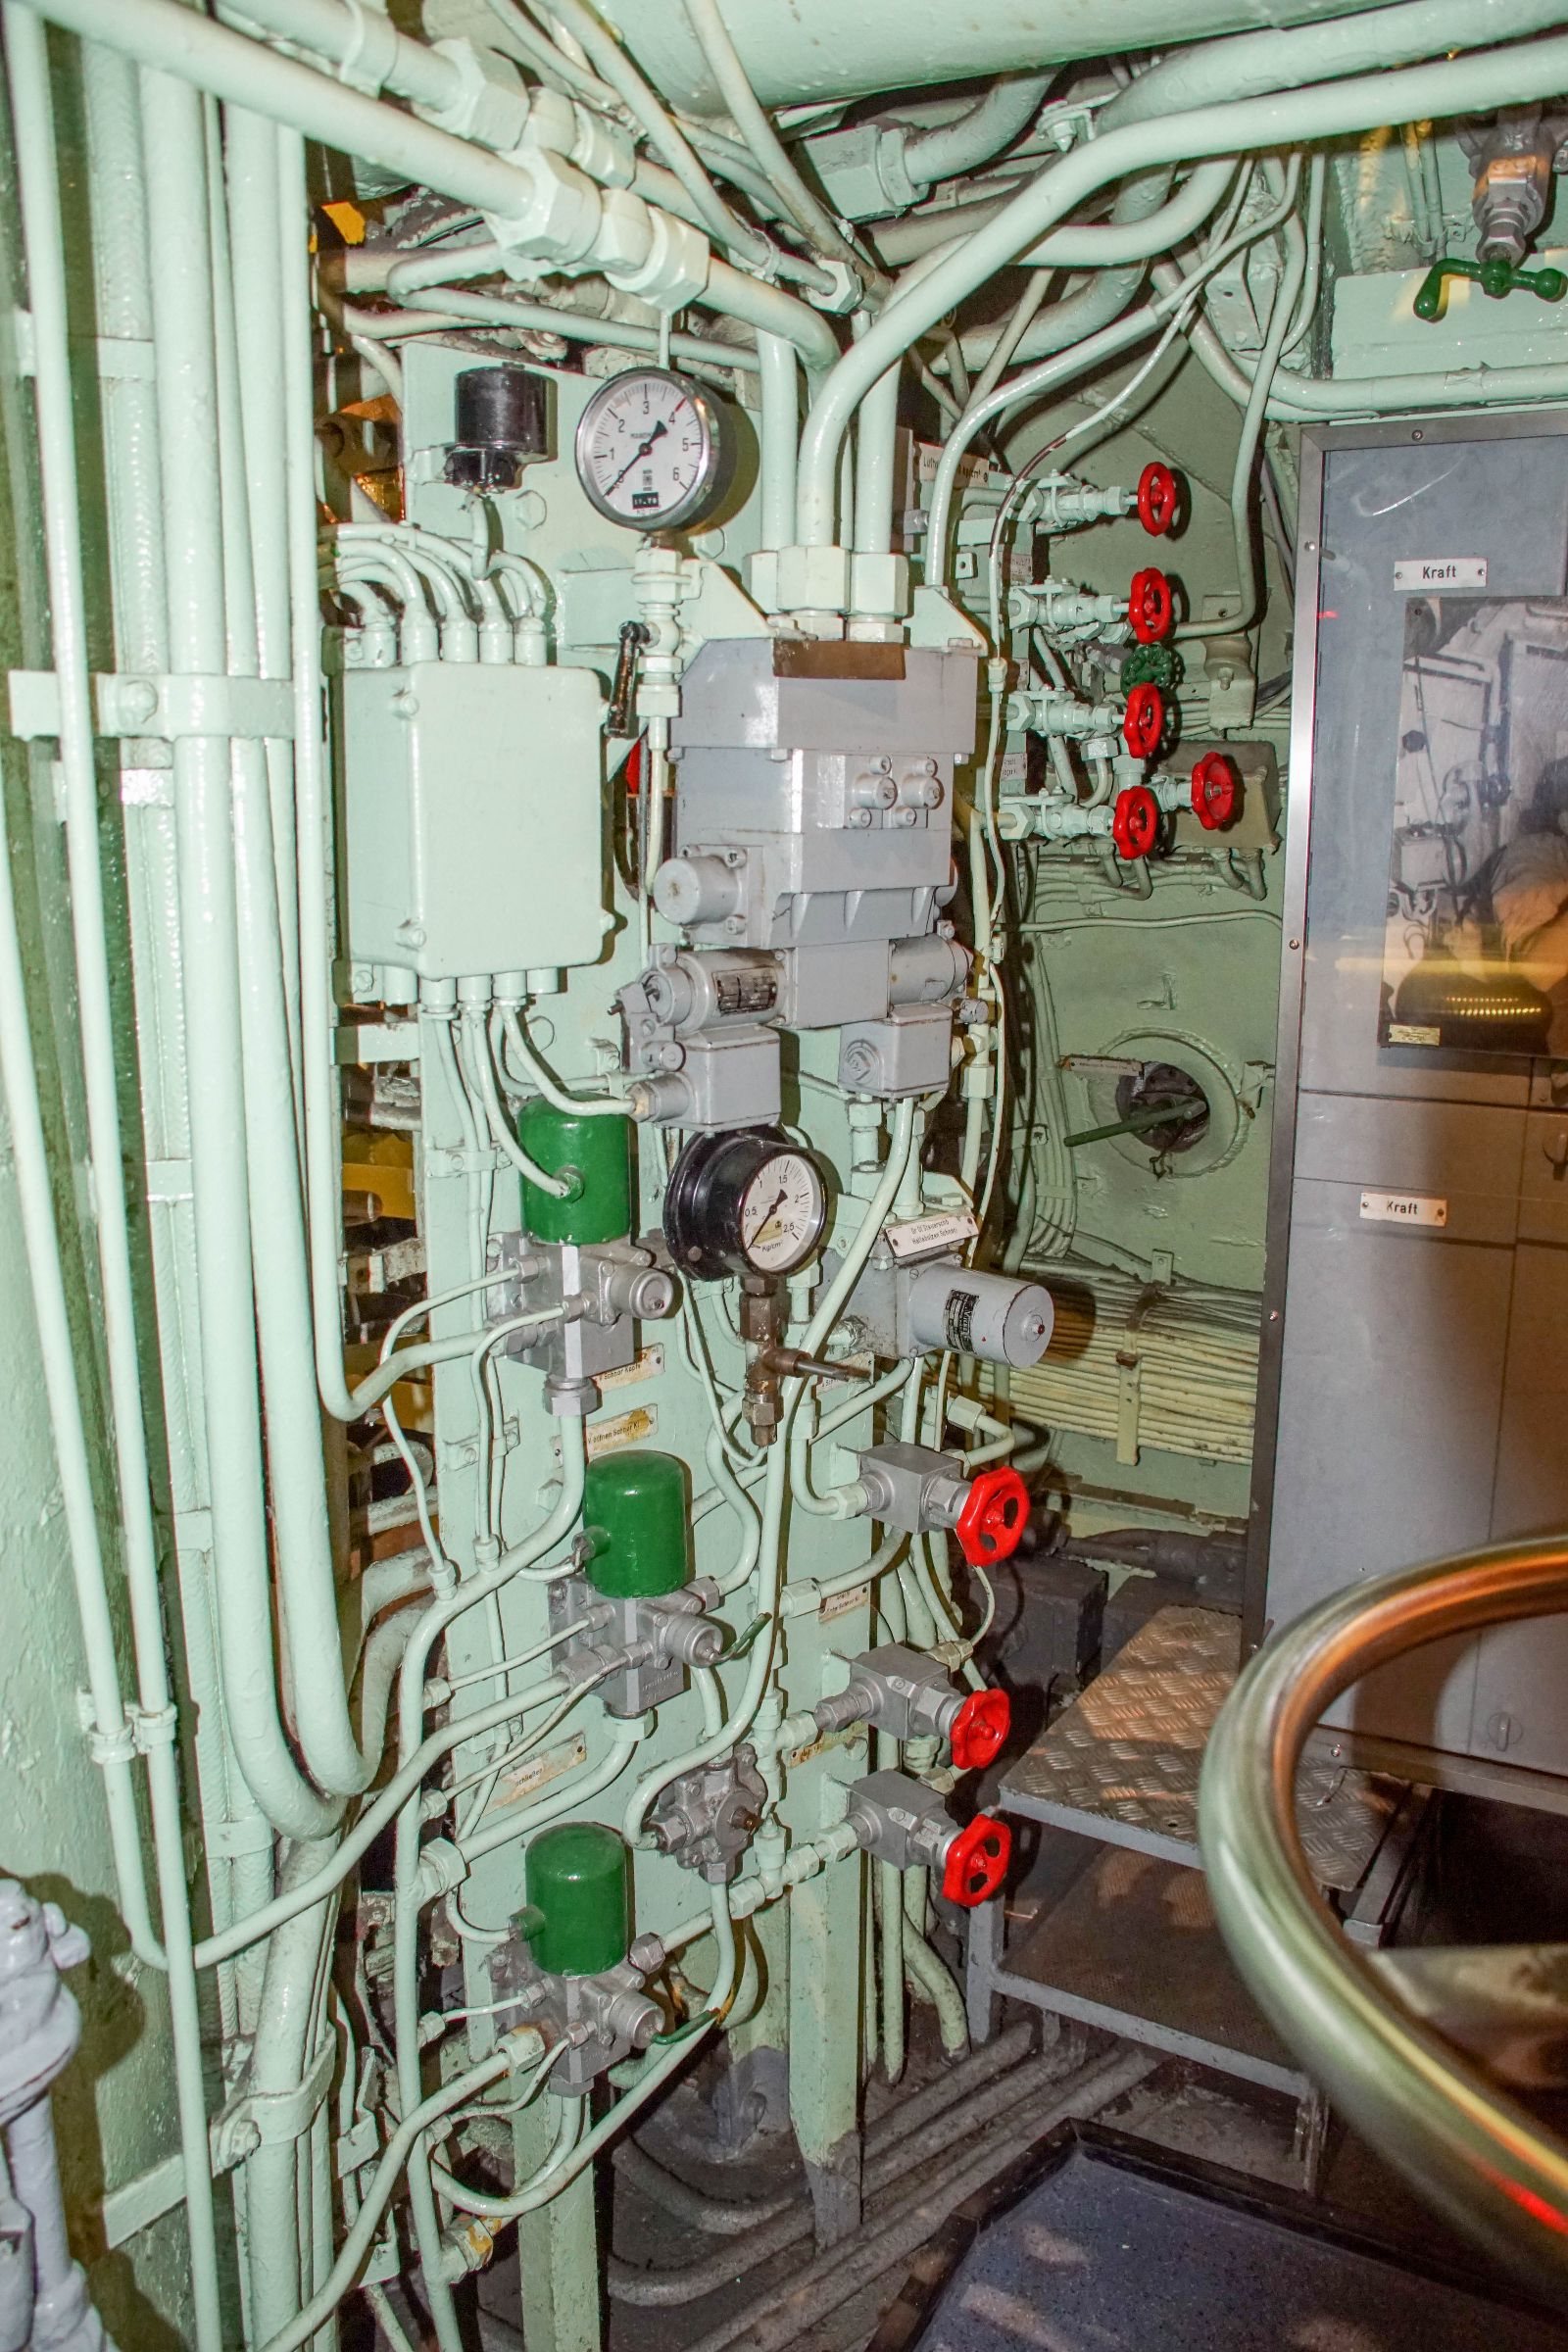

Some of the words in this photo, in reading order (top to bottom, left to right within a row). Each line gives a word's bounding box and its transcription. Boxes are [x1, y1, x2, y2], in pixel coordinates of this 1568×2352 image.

[642, 401, 650, 415] 3
[668, 412, 675, 424] 4
[618, 419, 625, 433] 2
[682, 438, 689, 452] 5
[610, 448, 614, 460] 1
[672, 467, 679, 481] 6
[1422, 565, 1456, 579] Kraft
[795, 1195, 800, 1203] 2
[1387, 1200, 1418, 1214] Kraft
